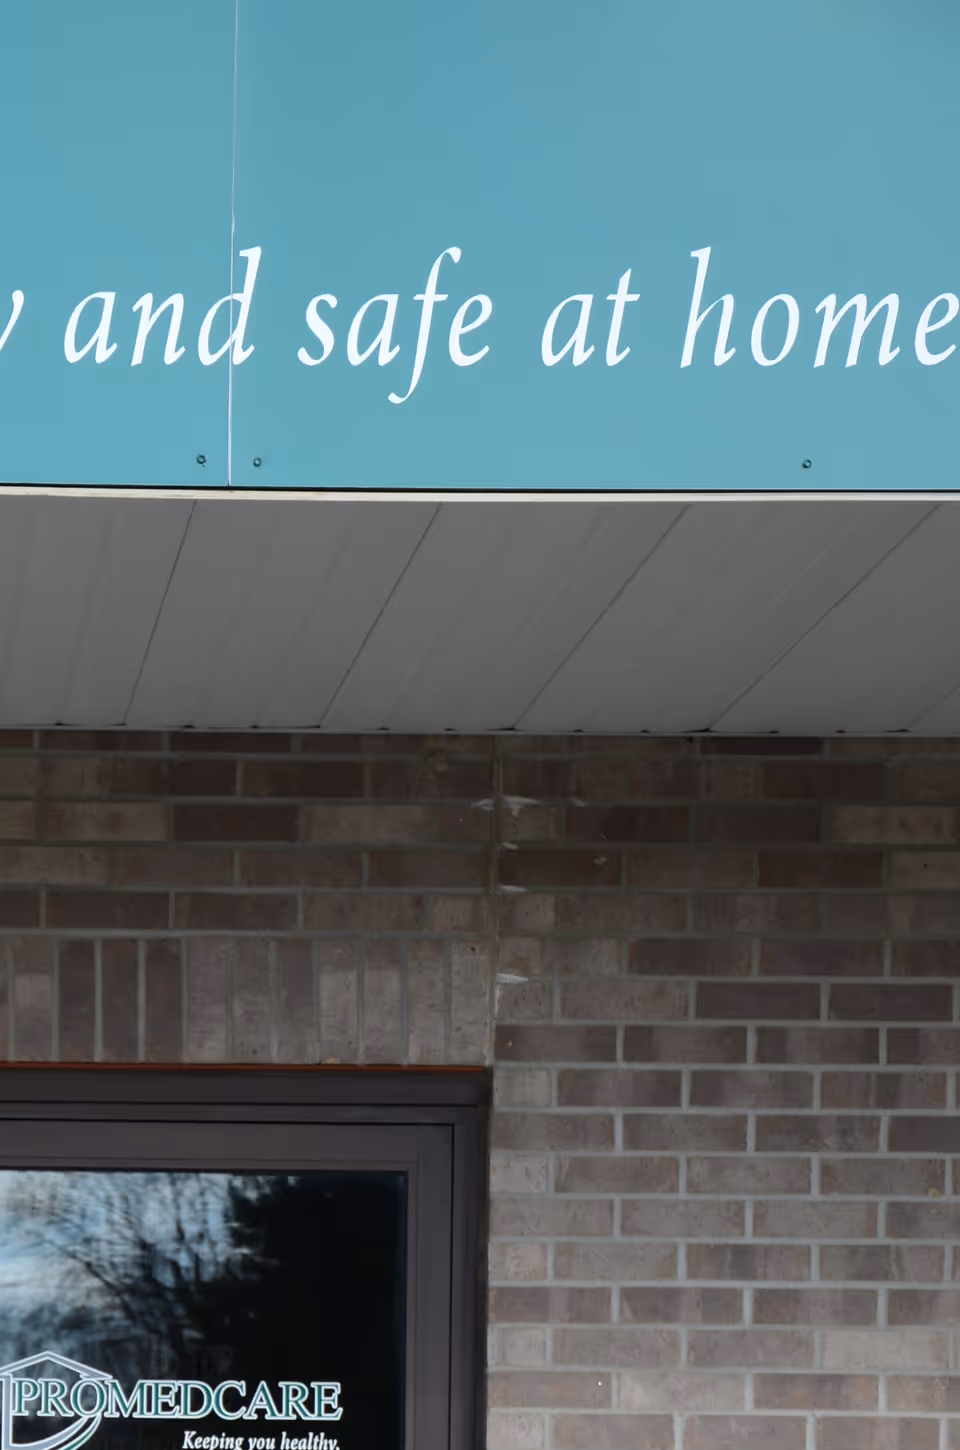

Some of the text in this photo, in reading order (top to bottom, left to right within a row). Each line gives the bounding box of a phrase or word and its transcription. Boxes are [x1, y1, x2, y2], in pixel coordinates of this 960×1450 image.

[65, 246, 262, 366] and
[297, 246, 493, 404] safe
[541, 268, 641, 367] at
[680, 246, 960, 368] home
[11, 1376, 344, 1422] PROMEDCARE
